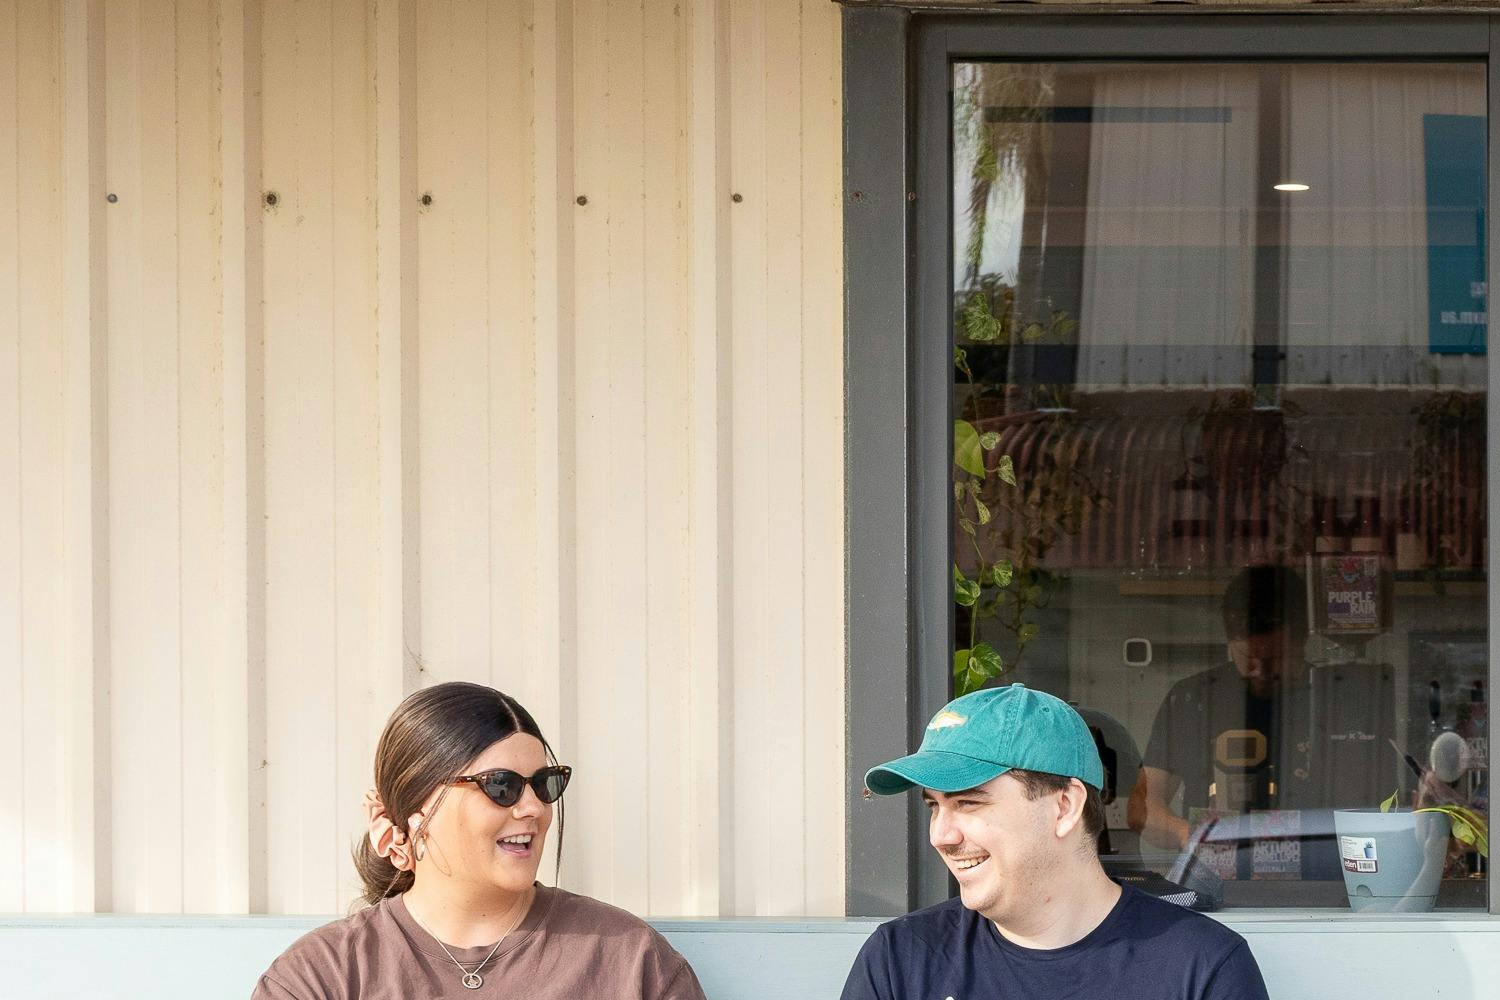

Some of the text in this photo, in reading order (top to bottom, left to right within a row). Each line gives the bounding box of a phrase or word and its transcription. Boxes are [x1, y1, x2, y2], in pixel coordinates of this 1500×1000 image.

[1328, 592, 1373, 604] PURPLE
[1350, 601, 1377, 614] RAIN
[1254, 841, 1301, 854] ARTURO
